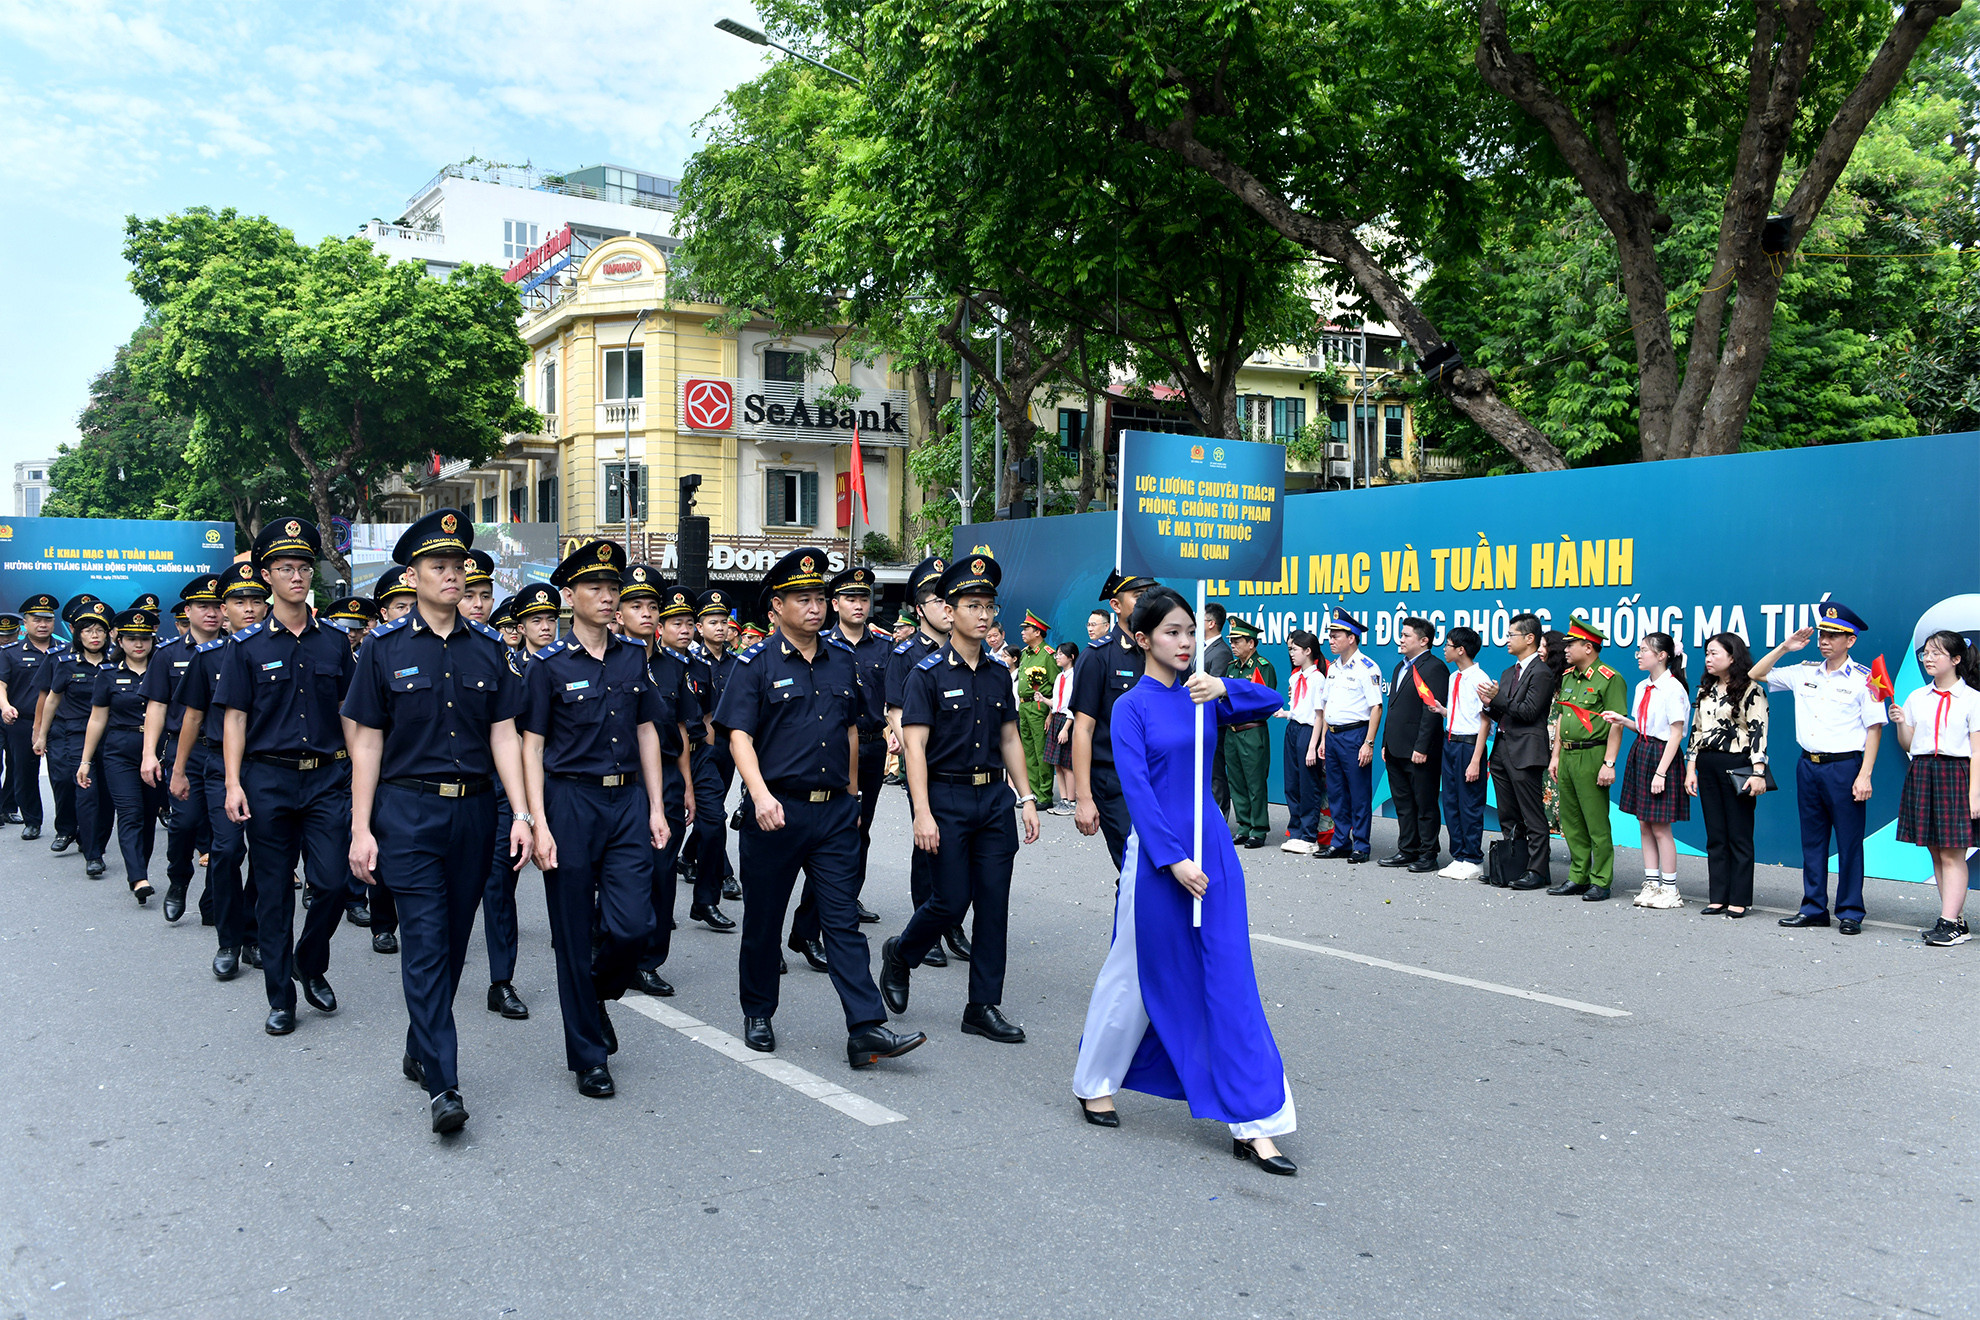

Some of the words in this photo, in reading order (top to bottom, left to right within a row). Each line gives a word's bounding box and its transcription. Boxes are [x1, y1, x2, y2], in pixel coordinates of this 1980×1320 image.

[744, 394, 903, 432] SeABank
[1135, 475, 1157, 495] LỰC
[1159, 476, 1195, 497] LƯỢNG
[1198, 481, 1239, 500] CHUYÊN
[1242, 484, 1275, 502] TRÁCH
[1138, 497, 1179, 517] PHÒNG,
[1182, 497, 1219, 518] CHỐNG
[1222, 502, 1239, 522] TỘI
[1241, 505, 1271, 524] PHẠM
[1158, 516, 1171, 536] VỀ
[1174, 521, 1191, 538] MA
[1194, 521, 1214, 539] TÚY
[1217, 523, 1252, 543] THUỘC
[44, 546, 55, 558] LỄ
[57, 549, 80, 559] KHAI
[82, 549, 104, 560] MẠC
[106, 548, 120, 560] VÀ
[121, 547, 146, 560] TUẦN
[148, 549, 174, 561] HÀNH
[1180, 539, 1199, 559] HẢI
[1201, 544, 1230, 560] QUAN
[4, 560, 34, 571] HƯỞNG
[34, 560, 53, 571] ỨNG
[54, 561, 80, 571] THÁNG
[81, 561, 104, 571] HÀNH
[104, 561, 126, 573] ĐỘNG
[127, 562, 156, 573] PHÒNG,
[156, 562, 183, 573] CHỐNG
[183, 564, 195, 573] MA
[1308, 552, 1371, 602] MẠC
[1380, 543, 1420, 593] VÀ
[1431, 531, 1517, 592] TUẦN
[1530, 534, 1634, 589] HÀNH
[1693, 604, 1751, 648] MA
